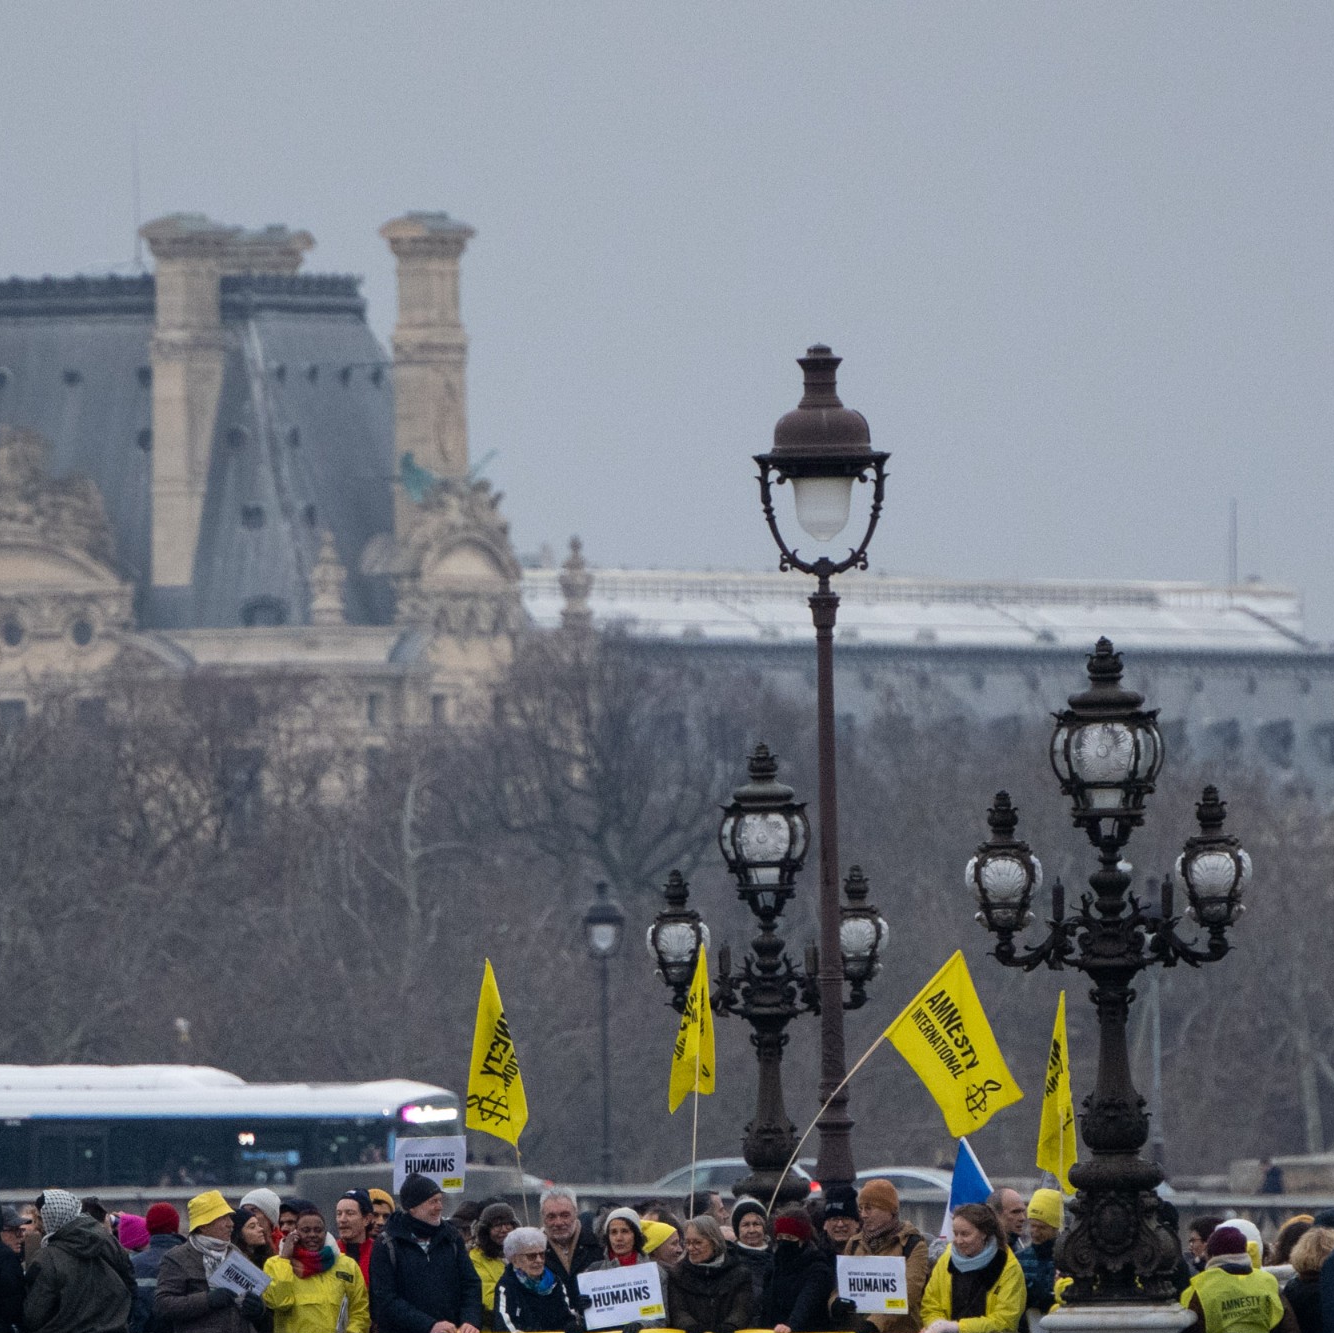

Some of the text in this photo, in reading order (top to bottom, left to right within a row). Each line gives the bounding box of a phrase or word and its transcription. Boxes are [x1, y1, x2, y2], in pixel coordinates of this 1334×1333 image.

[925, 989, 979, 1070] AMNESTY
[911, 1007, 964, 1080] INTERNATIONAL
[405, 1158, 455, 1174] HUMAINS
[224, 1266, 256, 1291] HUMAINS
[848, 1278, 897, 1293] HUMAINS
[593, 1286, 651, 1308] HUMAINS
[1221, 1296, 1260, 1312] AMNESTY
